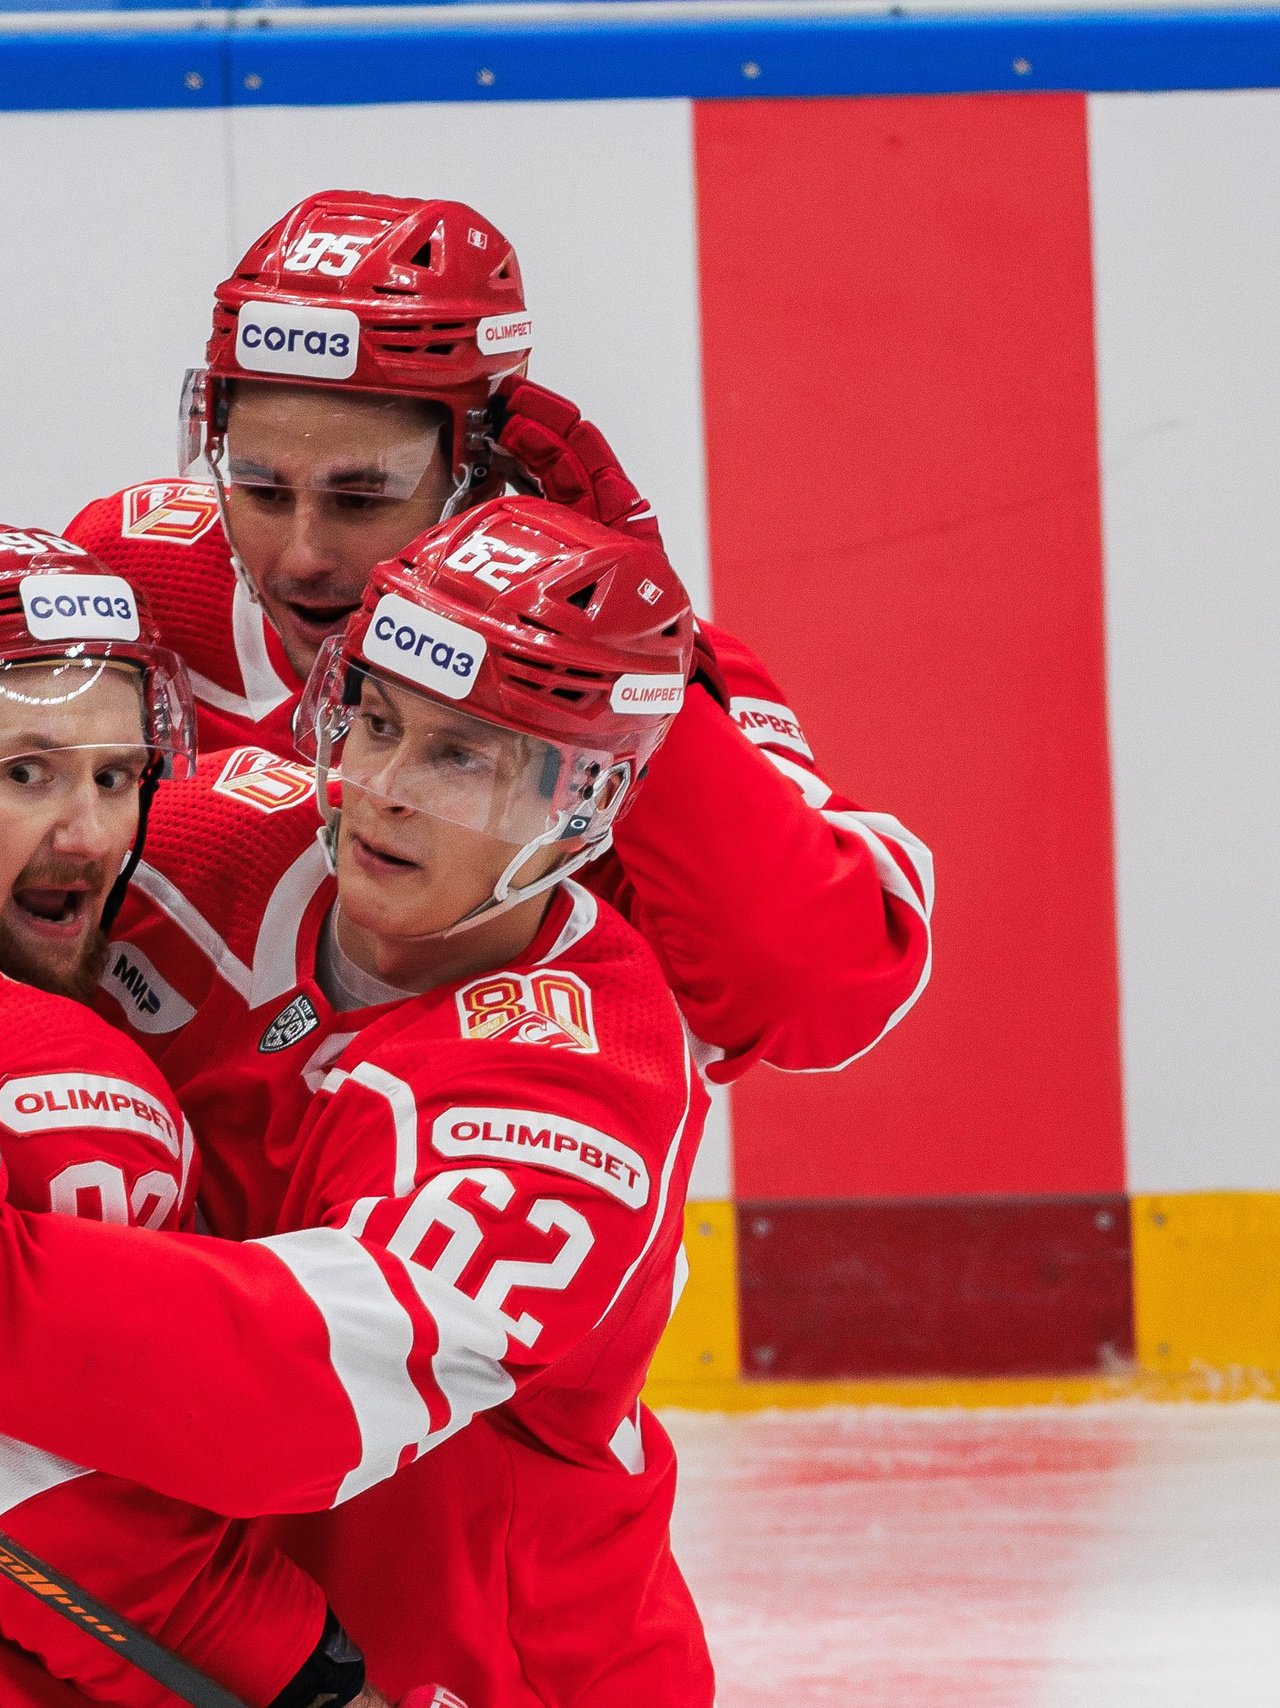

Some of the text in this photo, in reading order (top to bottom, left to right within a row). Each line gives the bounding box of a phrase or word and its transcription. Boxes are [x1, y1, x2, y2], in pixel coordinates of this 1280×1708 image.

[485, 320, 532, 342] OLIMPBET
[445, 533, 540, 592] 62
[621, 687, 684, 702] OLIMPBET
[14, 1089, 177, 1142] OLIMPBET
[451, 1121, 641, 1189] OLIMPBET
[386, 1167, 596, 1350] 62
